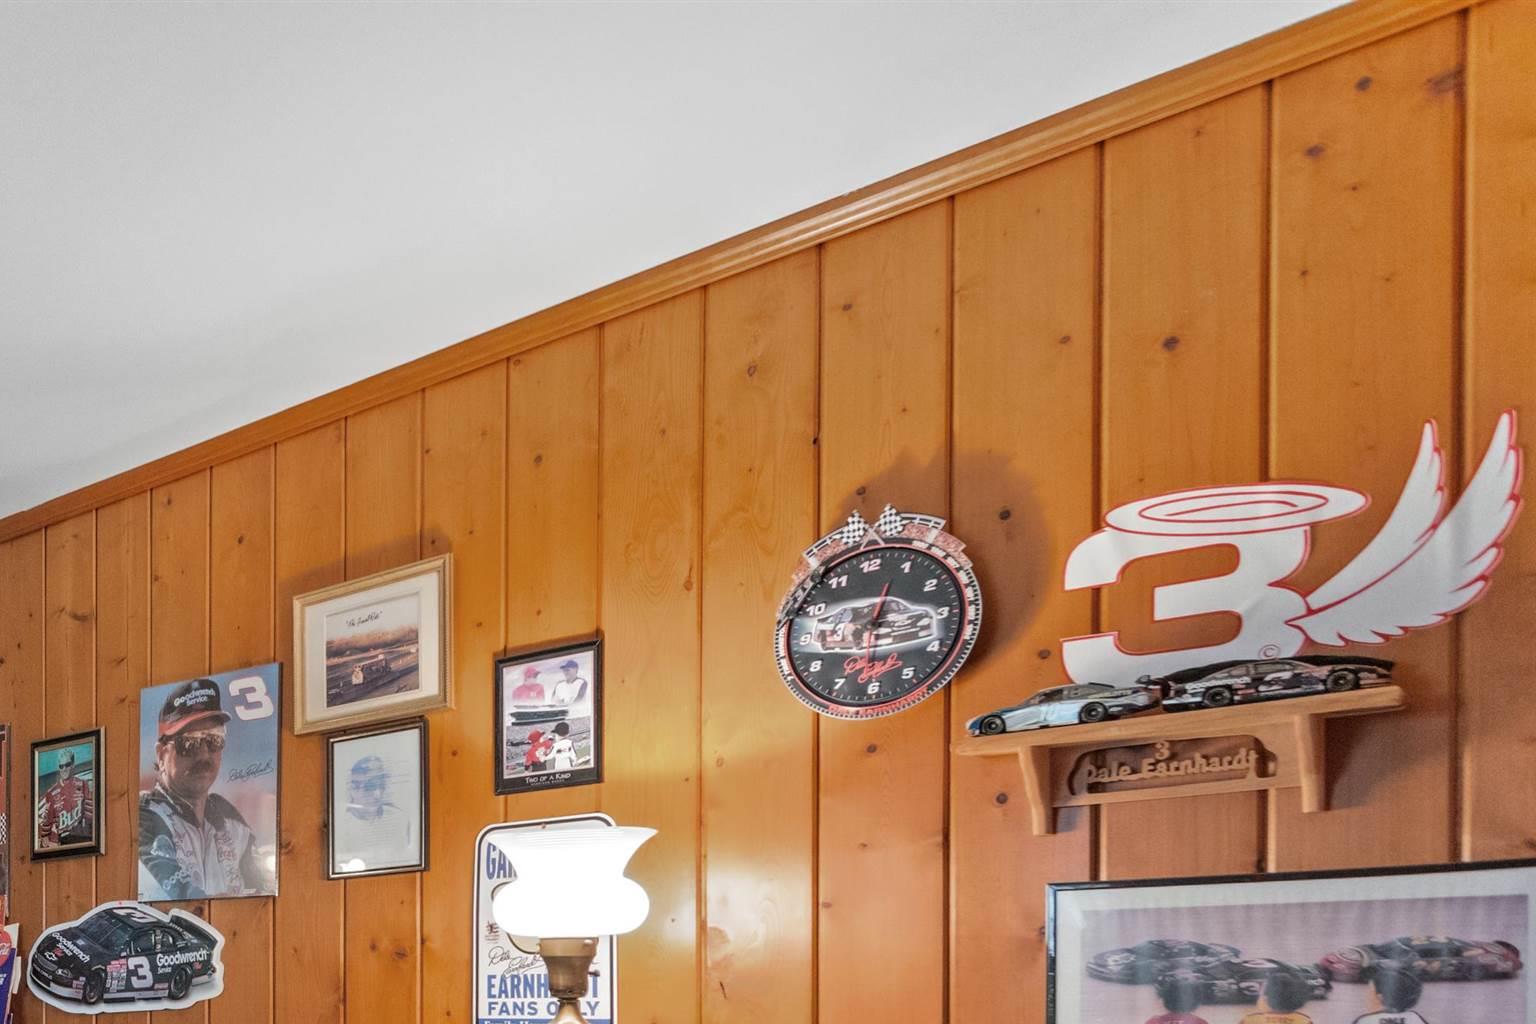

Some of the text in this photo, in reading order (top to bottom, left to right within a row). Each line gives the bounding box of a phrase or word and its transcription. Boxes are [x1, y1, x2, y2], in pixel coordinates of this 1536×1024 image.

[859, 558, 881, 573] 12
[900, 561, 912, 573] 1
[828, 575, 848, 588] 11
[923, 578, 938, 592] 2
[806, 603, 826, 616] 10
[936, 606, 950, 619] 3
[1062, 526, 1312, 690] 3
[800, 633, 811, 645] 9
[926, 640, 940, 652] 4
[809, 660, 822, 672] 8
[901, 667, 915, 679] 5
[834, 678, 846, 690] 7
[867, 682, 880, 694] 6
[229, 675, 274, 721] 3
[1155, 741, 1169, 760] 3
[1085, 748, 1258, 784] Dale Earnhardt
[59, 800, 82, 829] Bud
[52, 932, 90, 963] Goodwrench
[156, 948, 207, 966] Goodwrench
[128, 956, 154, 989] 3
[487, 973, 598, 998] EARNHT
[488, 1001, 538, 1016] FANS
